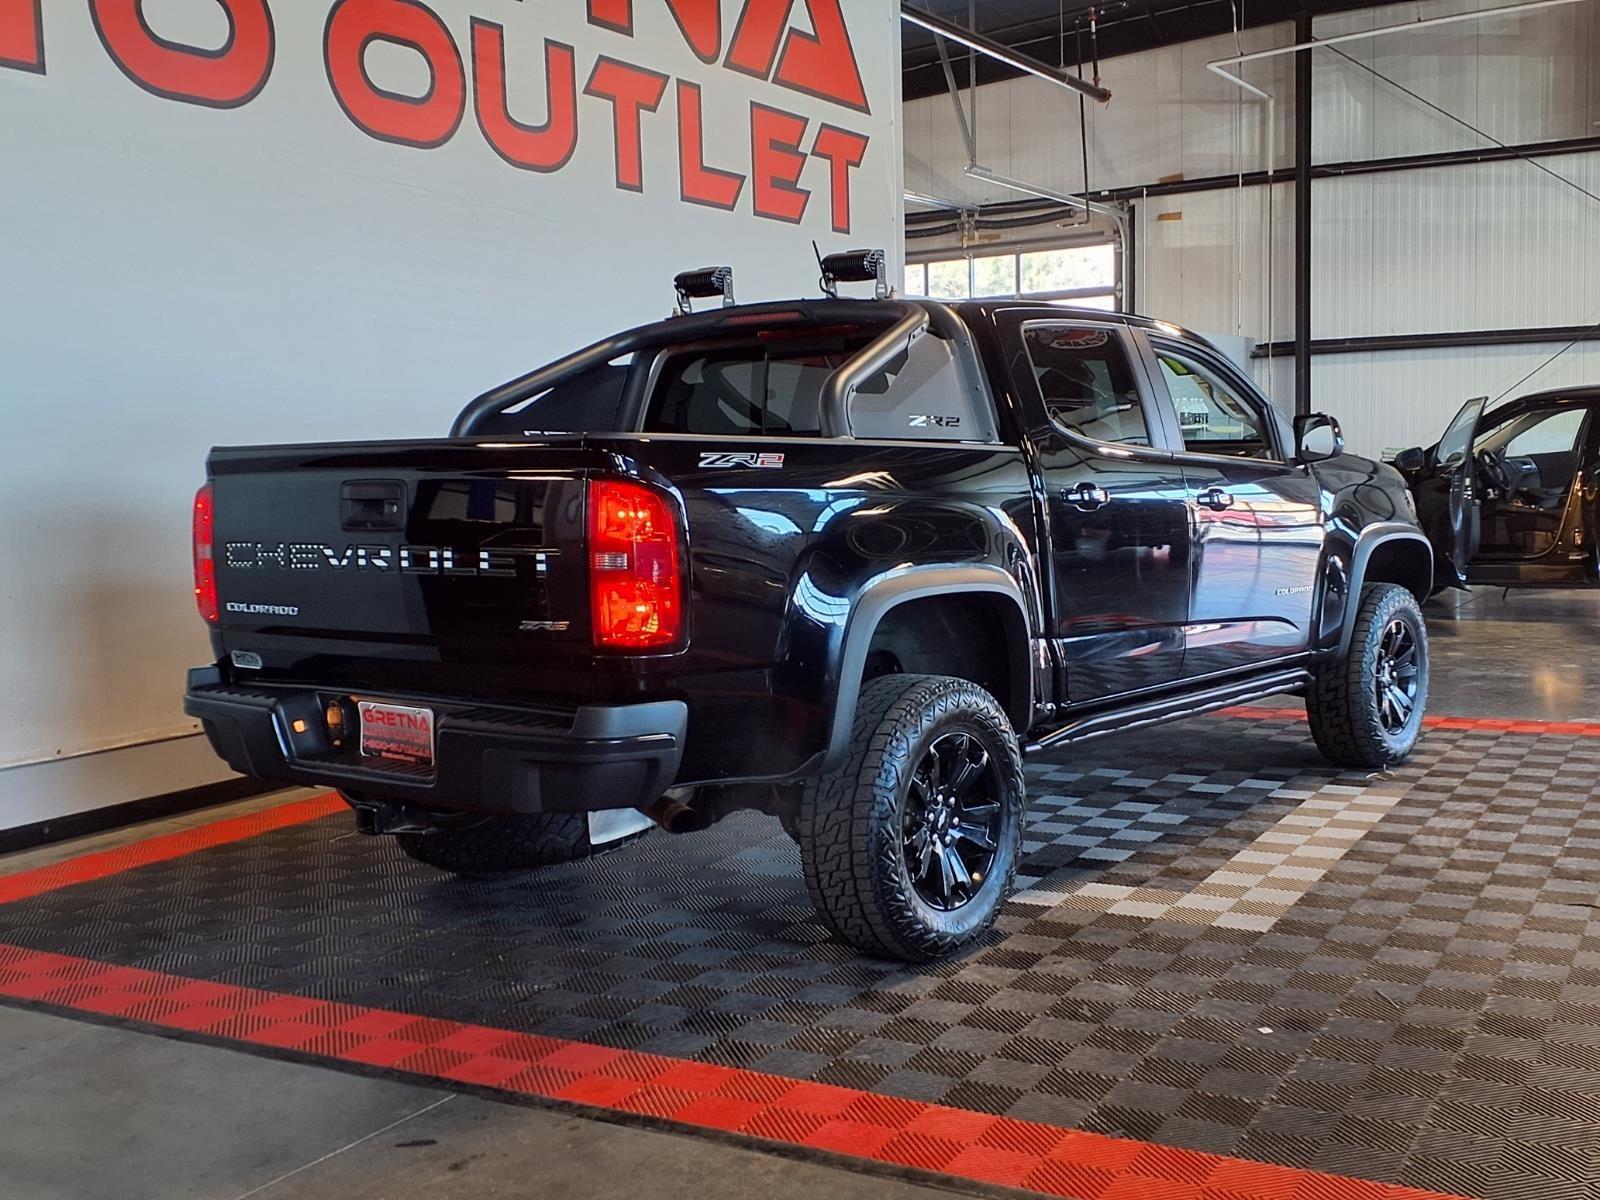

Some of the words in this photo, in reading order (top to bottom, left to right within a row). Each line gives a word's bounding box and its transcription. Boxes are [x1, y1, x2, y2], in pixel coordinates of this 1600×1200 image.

[323, 0, 871, 235] OUTLET
[908, 414, 961, 428] ZR2
[698, 452, 785, 469] ZR2
[226, 542, 561, 579] CHEVROLET
[1277, 585, 1314, 596] COLORADO
[226, 602, 299, 616] COLORADO
[363, 708, 431, 734] GRETNA
